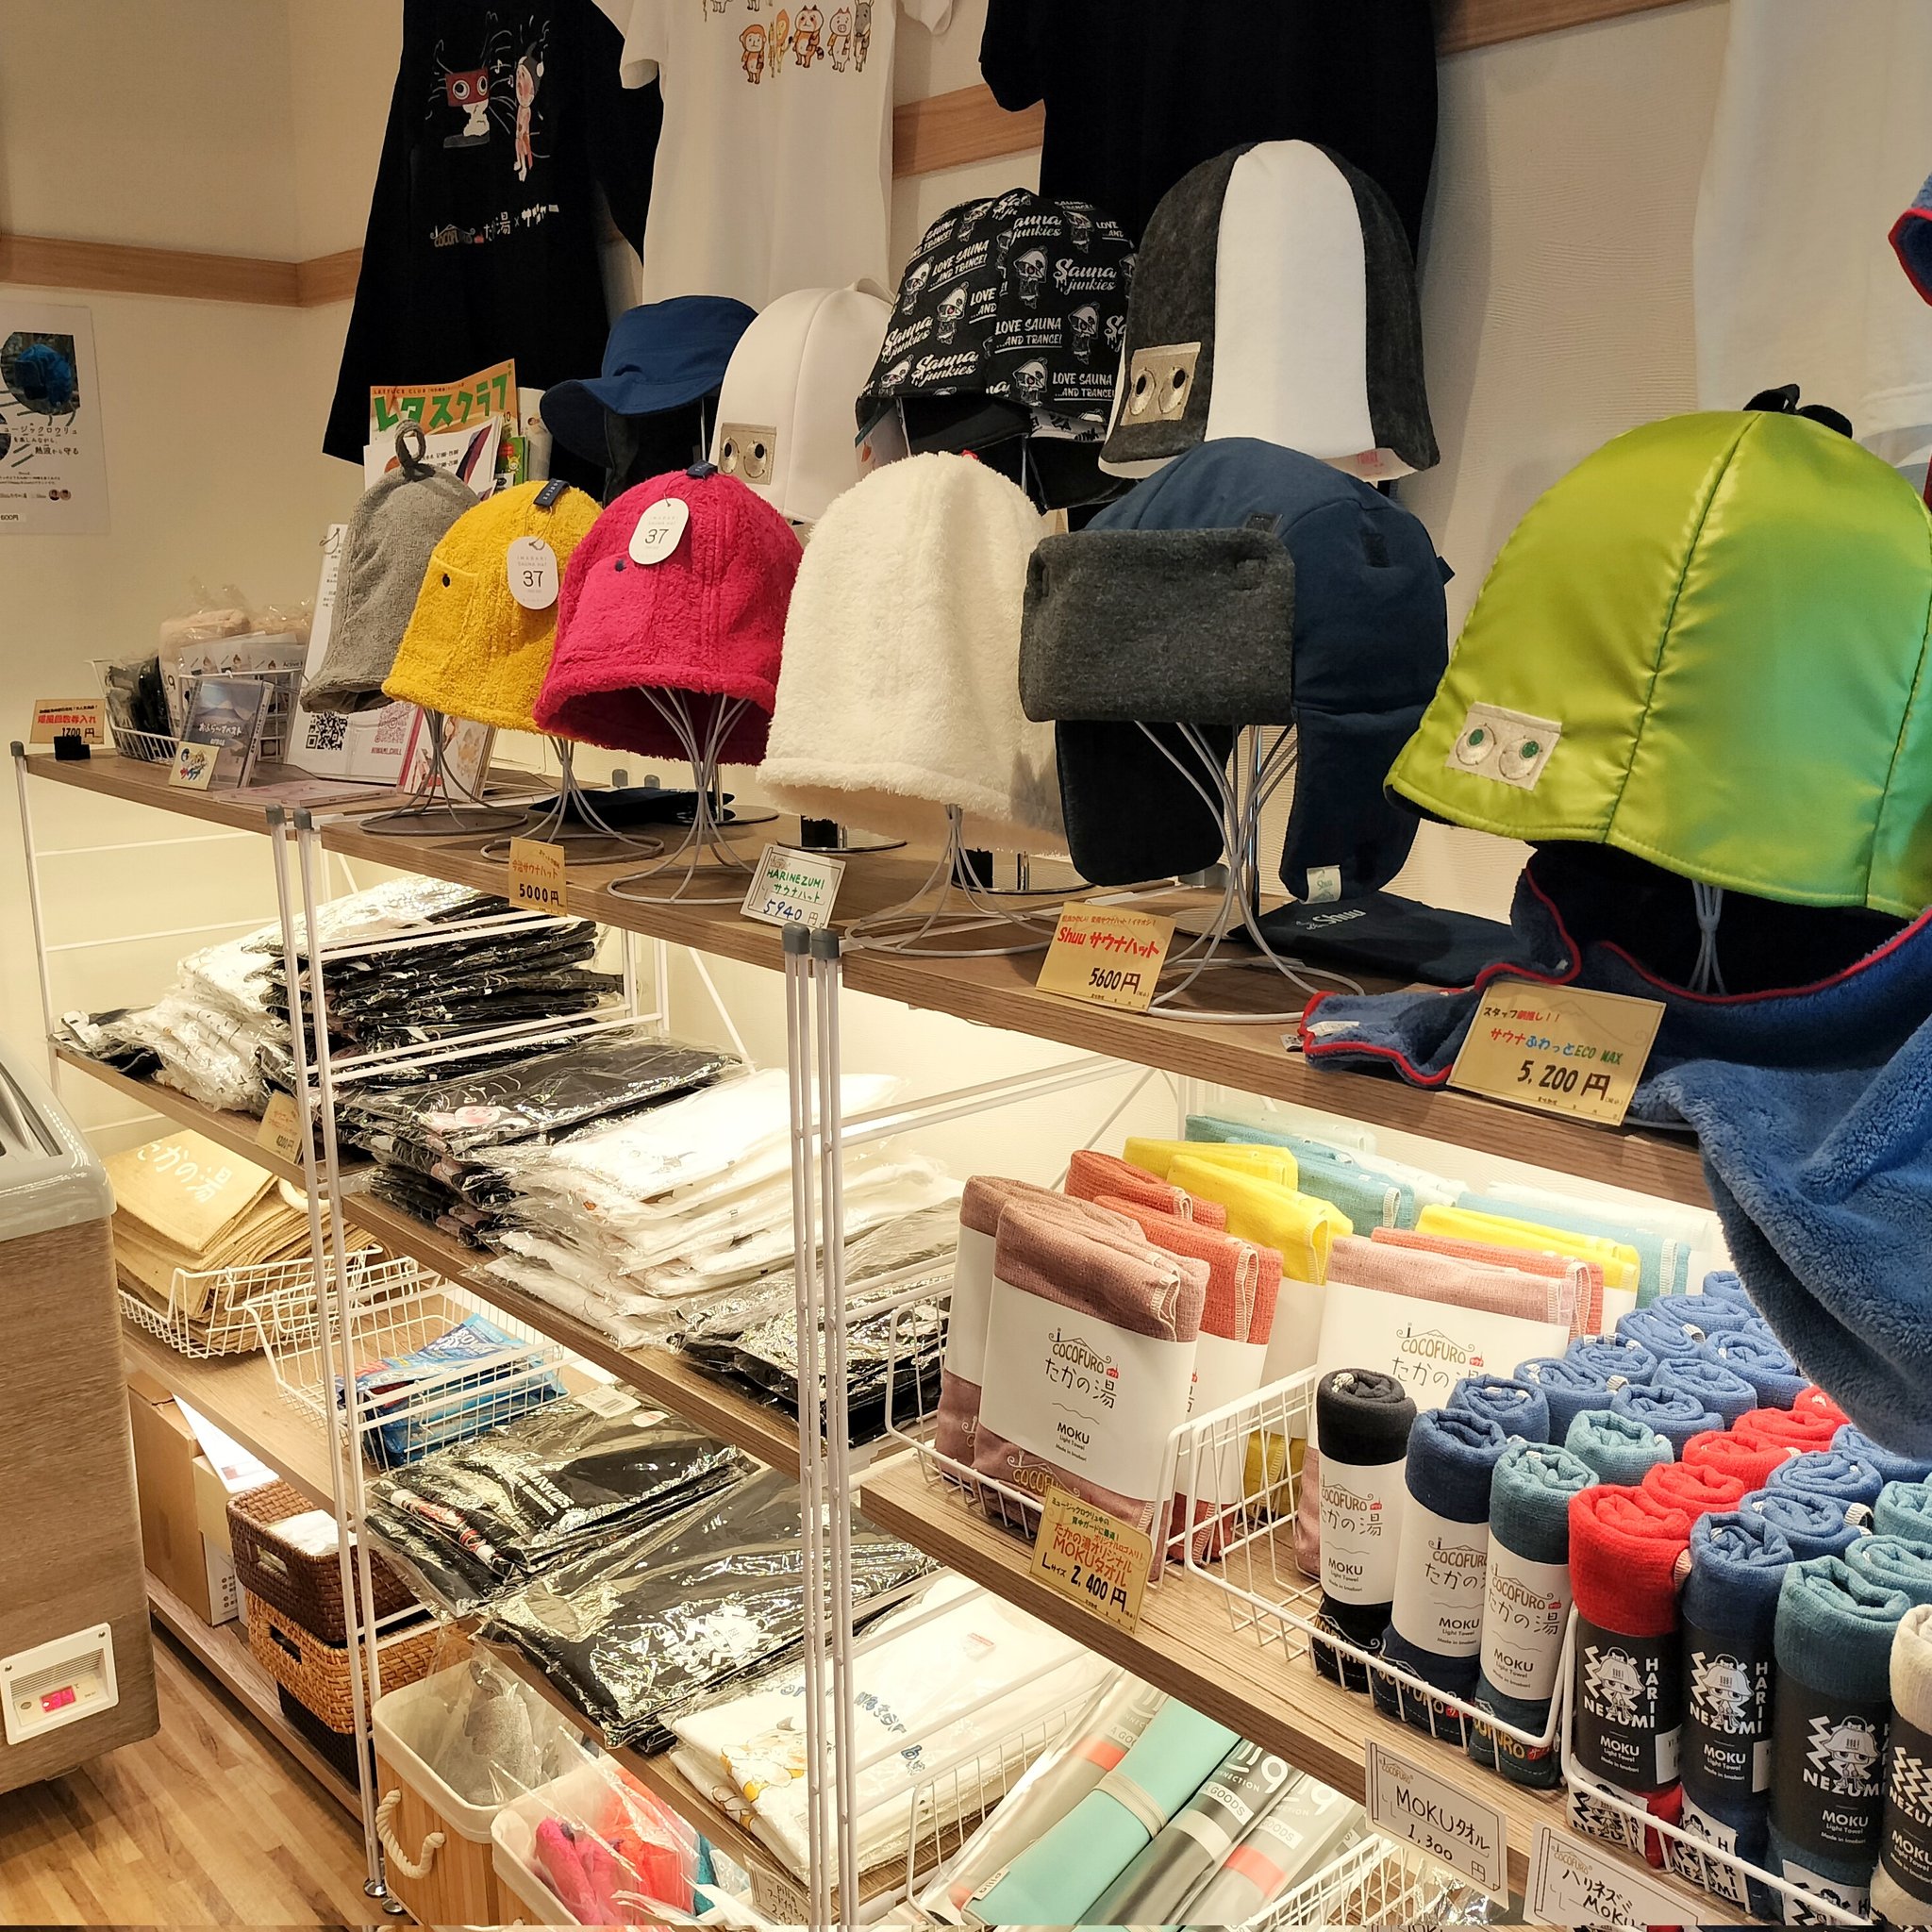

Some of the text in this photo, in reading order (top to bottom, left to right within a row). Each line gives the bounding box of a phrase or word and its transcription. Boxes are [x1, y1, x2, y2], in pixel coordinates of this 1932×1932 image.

[932, 240, 991, 277] LOVE SAUNA
[1053, 258, 1117, 290] Sauna
[970, 288, 997, 307] LOVE
[1064, 278, 1116, 295] junkies
[994, 317, 1062, 336] LOVE SAUNA
[881, 316, 934, 364] Sauna
[1026, 333, 1063, 345] TRANCE!
[911, 351, 979, 386] Sauna
[919, 364, 977, 388] junkies
[1052, 372, 1112, 386] LOVE SAUNA
[644, 528, 670, 544] 37
[523, 570, 544, 588] 37
[766, 869, 825, 891] HARINEZUMI
[519, 883, 559, 907] 5000円
[774, 884, 820, 903] サウナハット
[1312, 908, 1367, 926] Shuu
[1057, 926, 1159, 958] Shuu サウナハット
[1088, 967, 1141, 995] 5600円
[1052, 1343, 1105, 1374] COCOFURO
[1401, 1338, 1467, 1365] COCOFURO
[1045, 1357, 1117, 1409] たかの湯
[1057, 1422, 1091, 1445] MOKU
[1322, 1488, 1368, 1511] COCOFURO
[1053, 1535, 1126, 1587] MOKUタオル
[1327, 1557, 1363, 1575] MOKU
[1491, 1577, 1546, 1610] COCOFURO
[1439, 1617, 1480, 1630] MOKU
[1488, 1588, 1560, 1636] たかの湯
[1493, 1648, 1534, 1673] MOKU
[1584, 1695, 1656, 1729] NEZUMI
[1690, 1702, 1763, 1736] NEZUMI
[1600, 1735, 1640, 1757] MOKU
[1704, 1743, 1747, 1764] MOKU
[1210, 1786, 1246, 1818] GOODS
[1396, 1785, 1491, 1851] MOKUタオル
[1822, 1809, 1869, 1828] MOKU
[1891, 1830, 1932, 1866] MOKU
[1562, 1869, 1634, 1914] ハリネズミ
